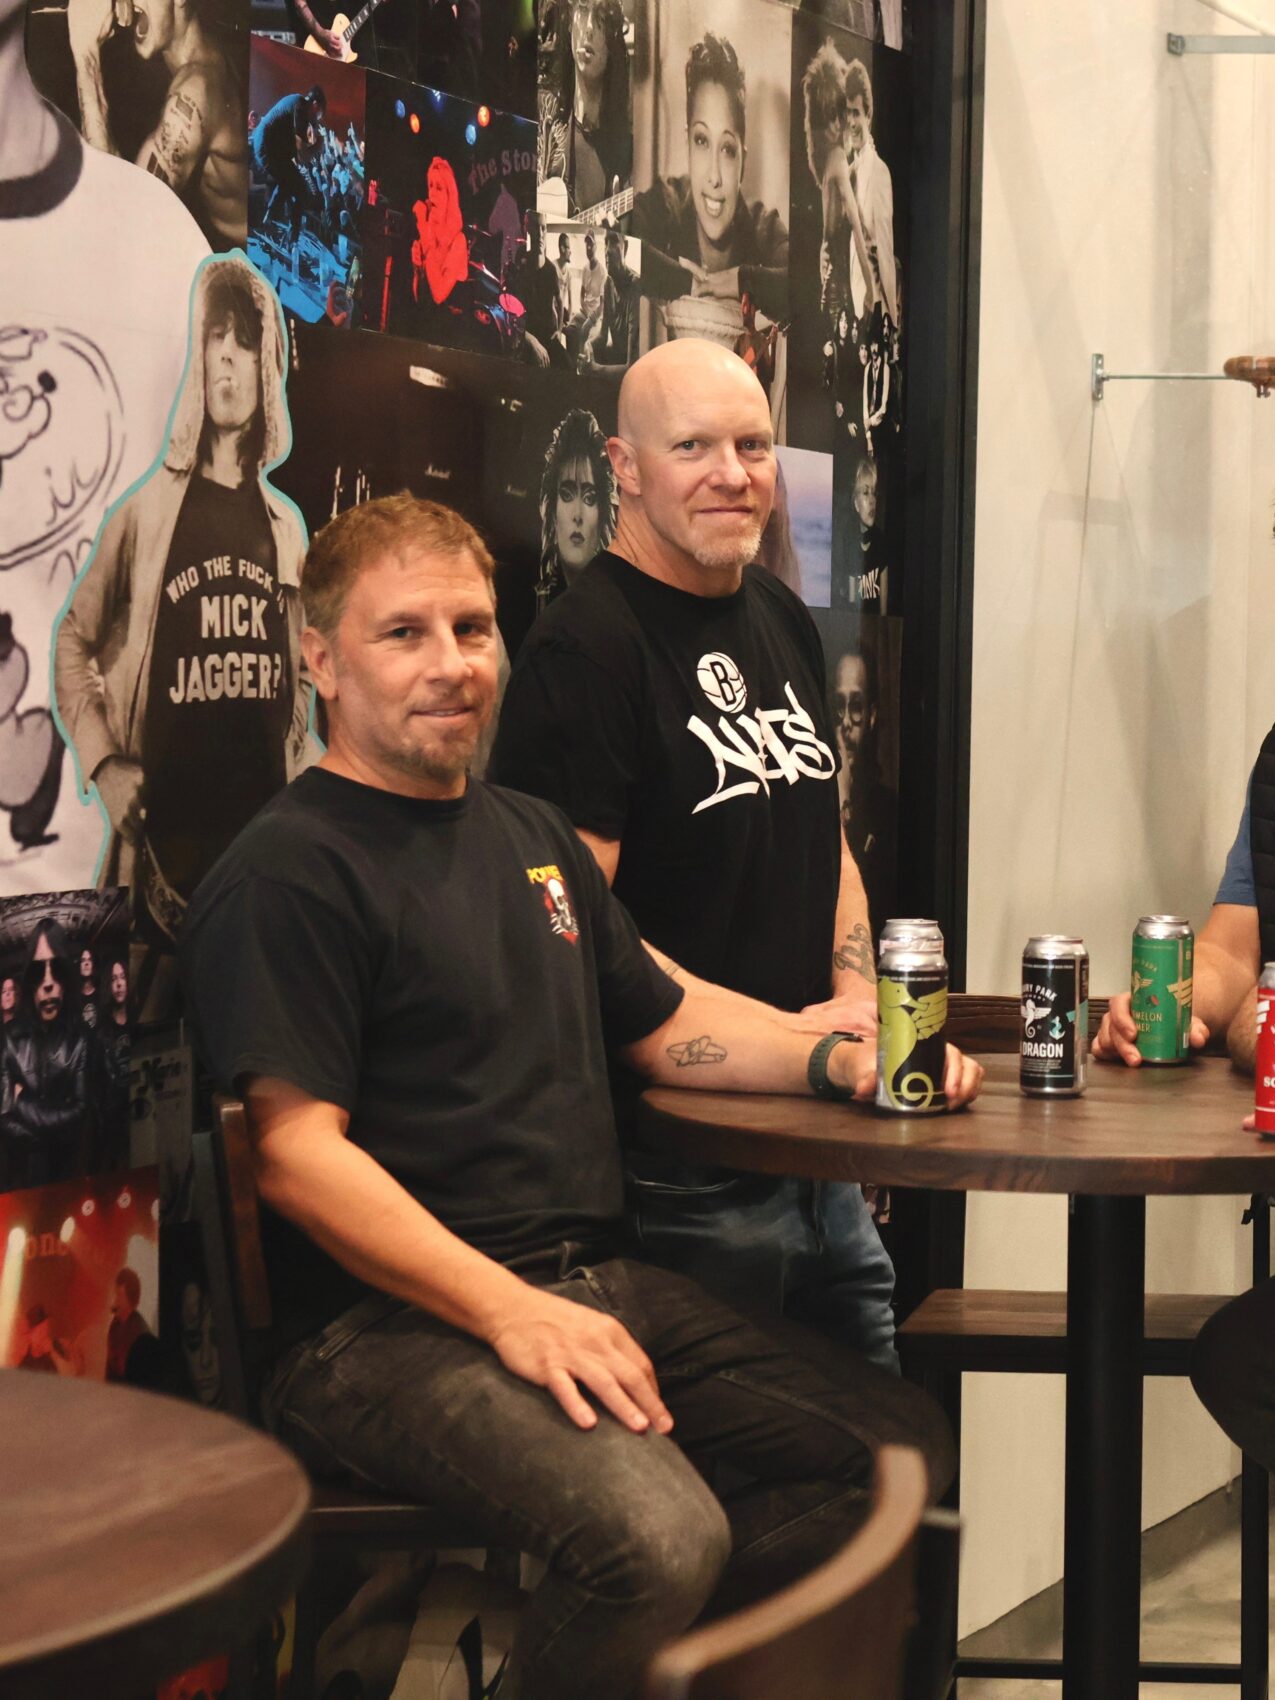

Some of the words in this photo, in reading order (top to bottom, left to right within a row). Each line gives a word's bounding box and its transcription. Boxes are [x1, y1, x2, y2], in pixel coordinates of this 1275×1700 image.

[166, 566, 200, 604] WHO
[203, 555, 232, 580] THE
[238, 558, 274, 593] FUCK
[201, 593, 268, 640] MICK
[169, 652, 282, 704] JAGGER?
[710, 661, 737, 706] B
[1036, 985, 1057, 1002] PARK
[1022, 1042, 1064, 1058] DRAGON
